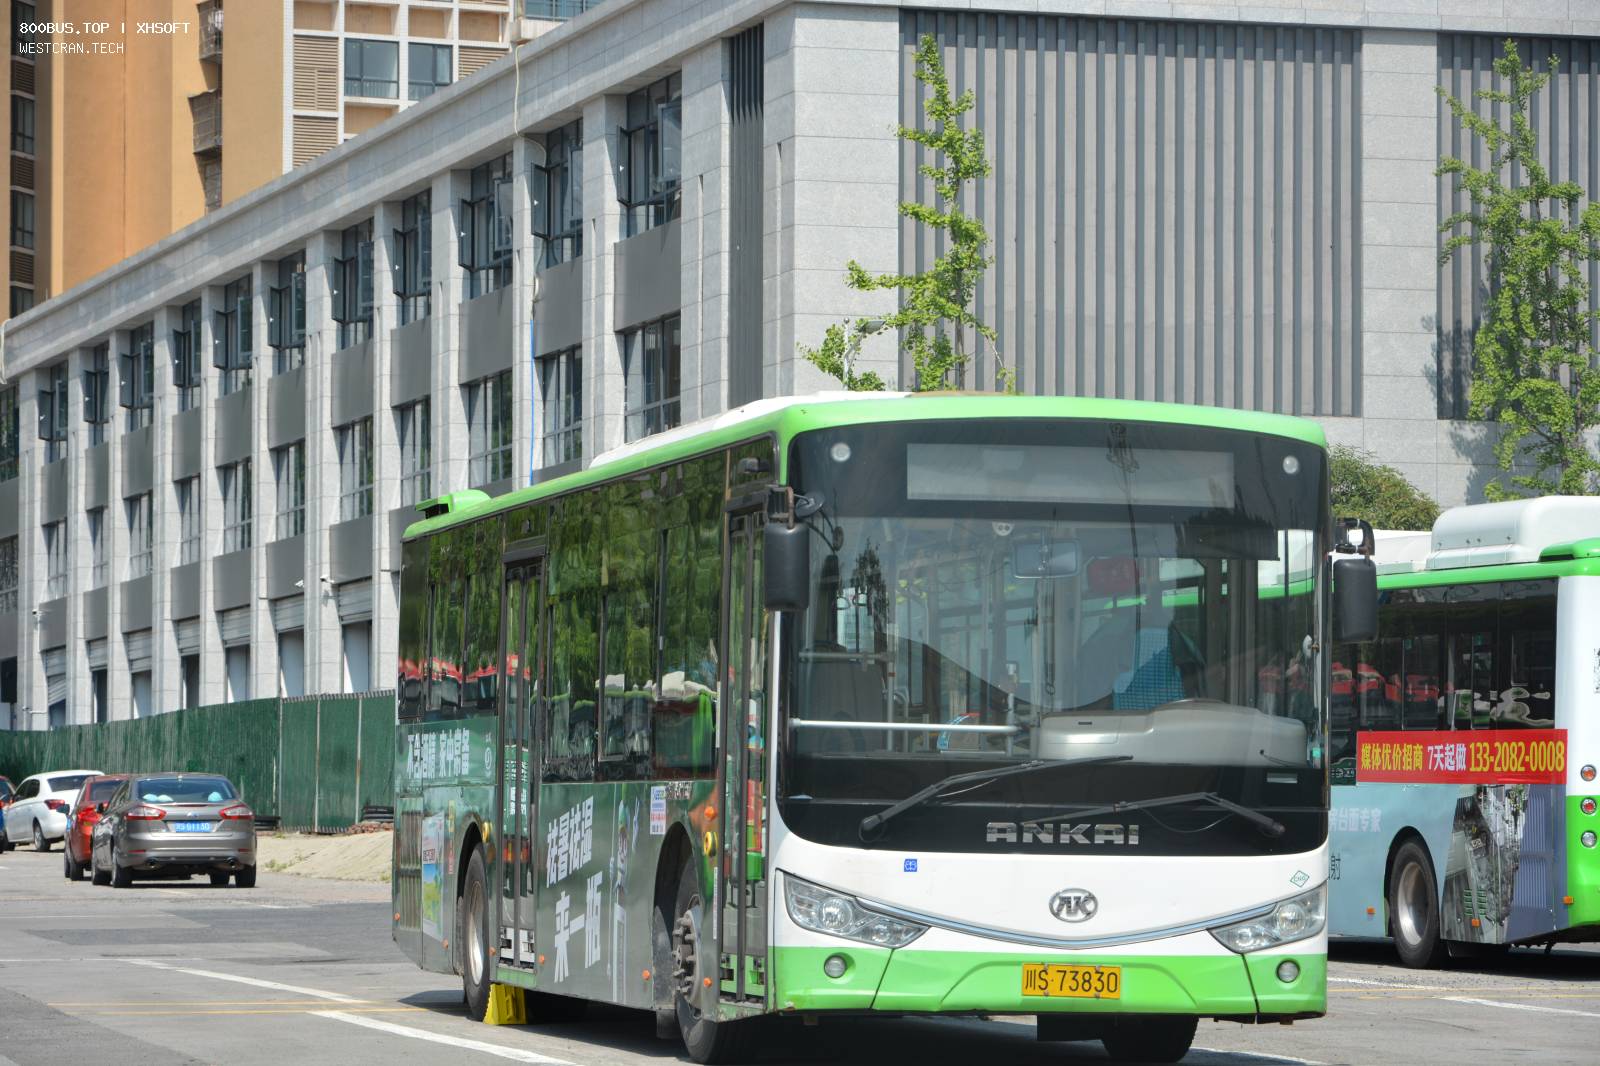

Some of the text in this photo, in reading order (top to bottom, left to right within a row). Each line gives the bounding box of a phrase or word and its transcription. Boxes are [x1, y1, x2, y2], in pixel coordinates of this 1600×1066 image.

[1361, 743, 1423, 771] 媒体优价招商
[1469, 741, 1565, 772] 133-2082-0008
[546, 795, 594, 888] 祛暑祛湿
[986, 821, 1139, 845] ANKAI
[554, 871, 603, 983] 来一瓶
